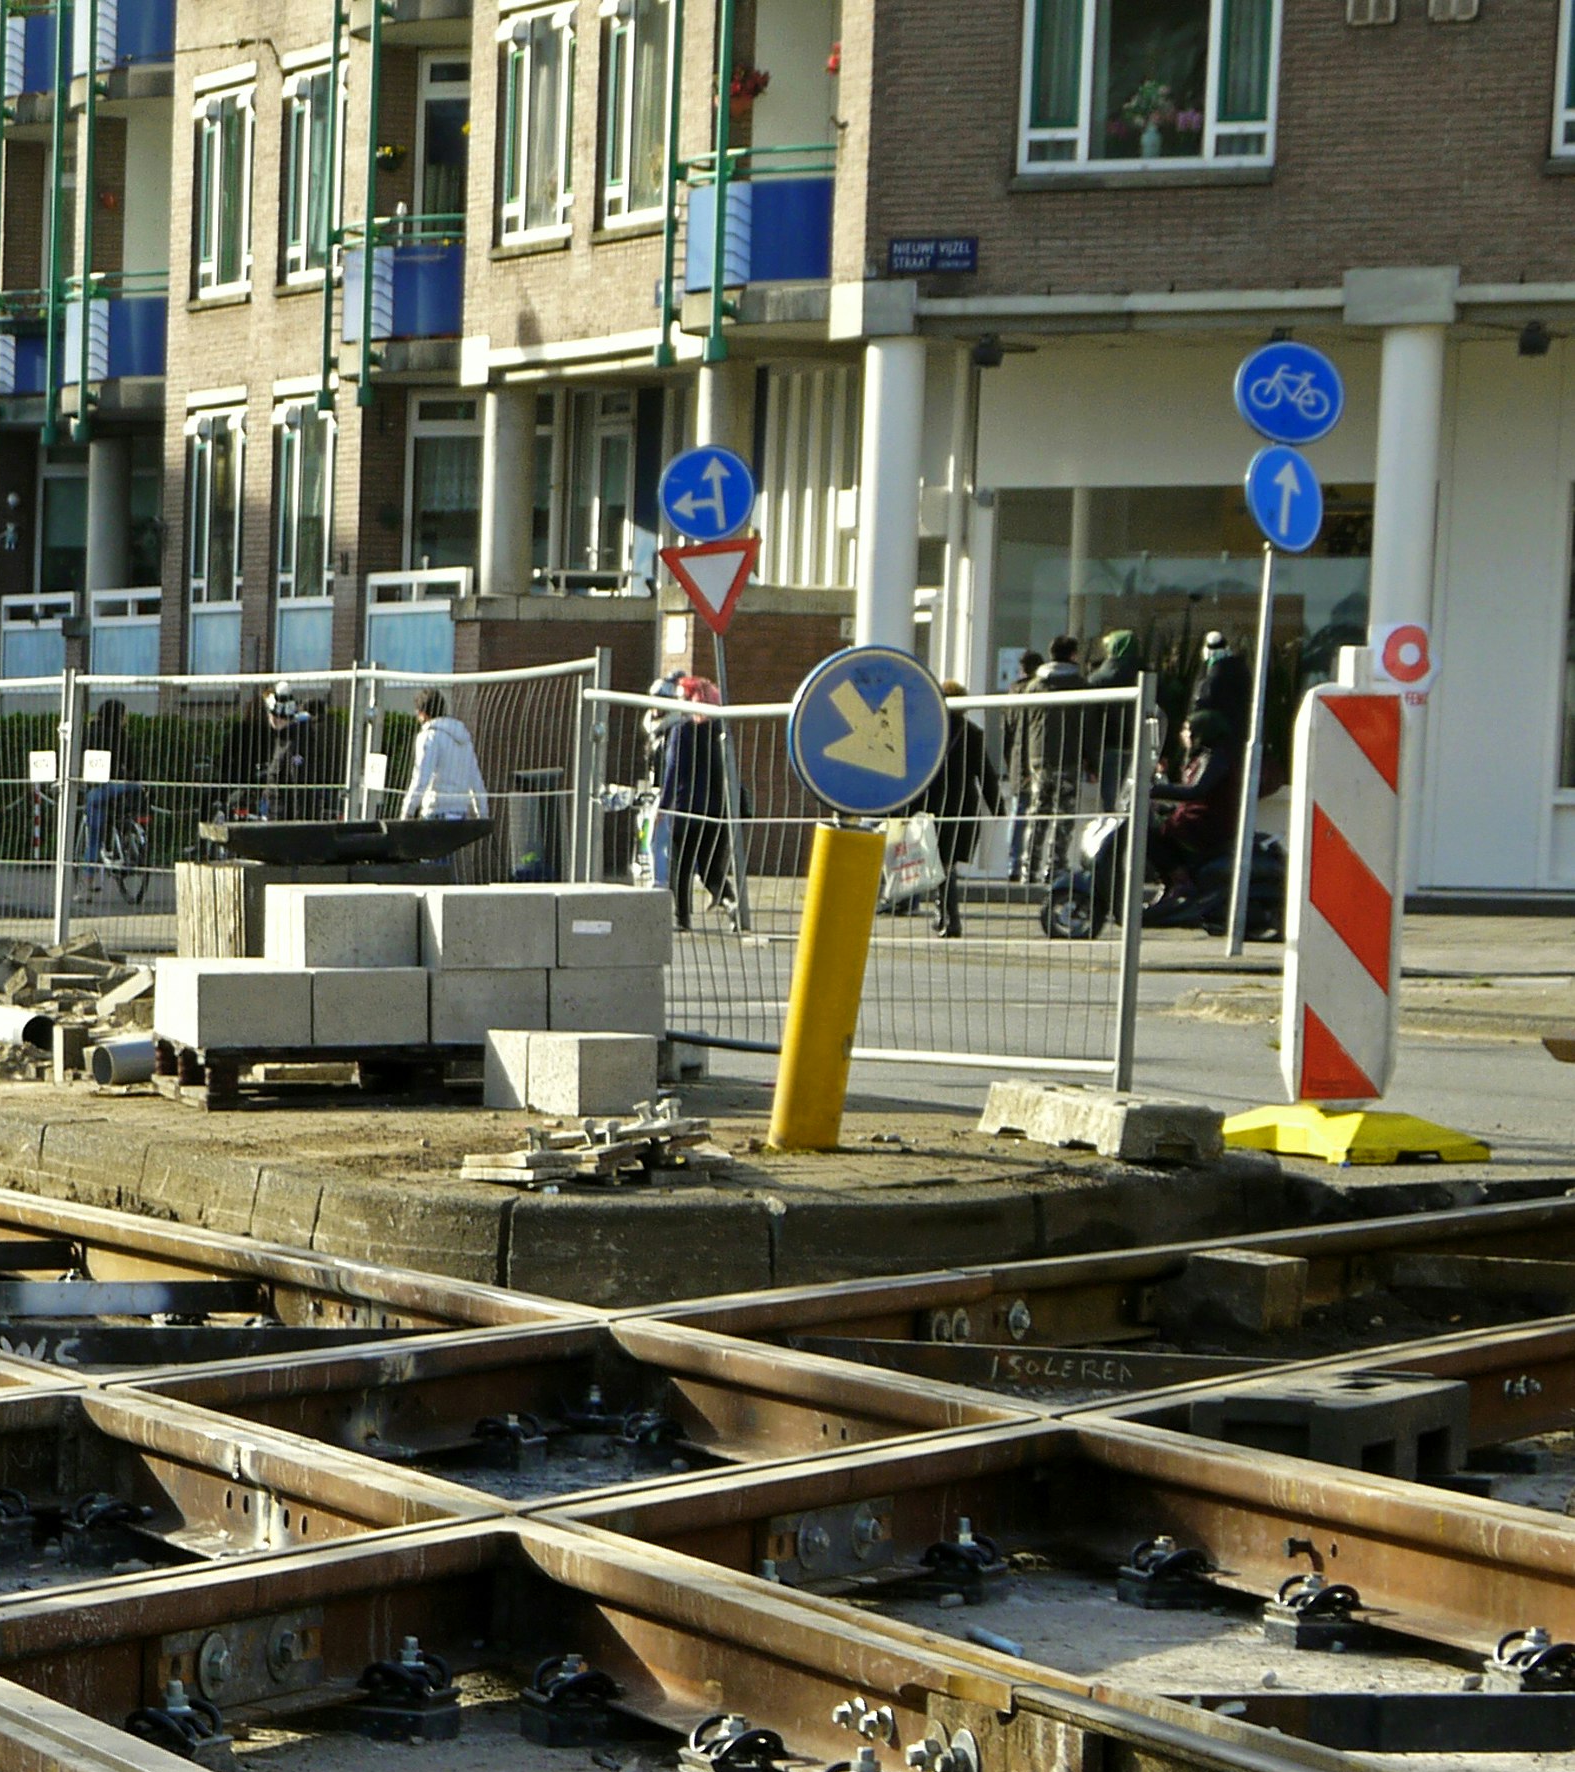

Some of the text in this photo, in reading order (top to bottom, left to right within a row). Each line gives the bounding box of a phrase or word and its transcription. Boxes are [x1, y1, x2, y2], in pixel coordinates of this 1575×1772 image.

[893, 241, 971, 257] NIEUWE VIJZEL
[892, 257, 931, 269] STRAAT
